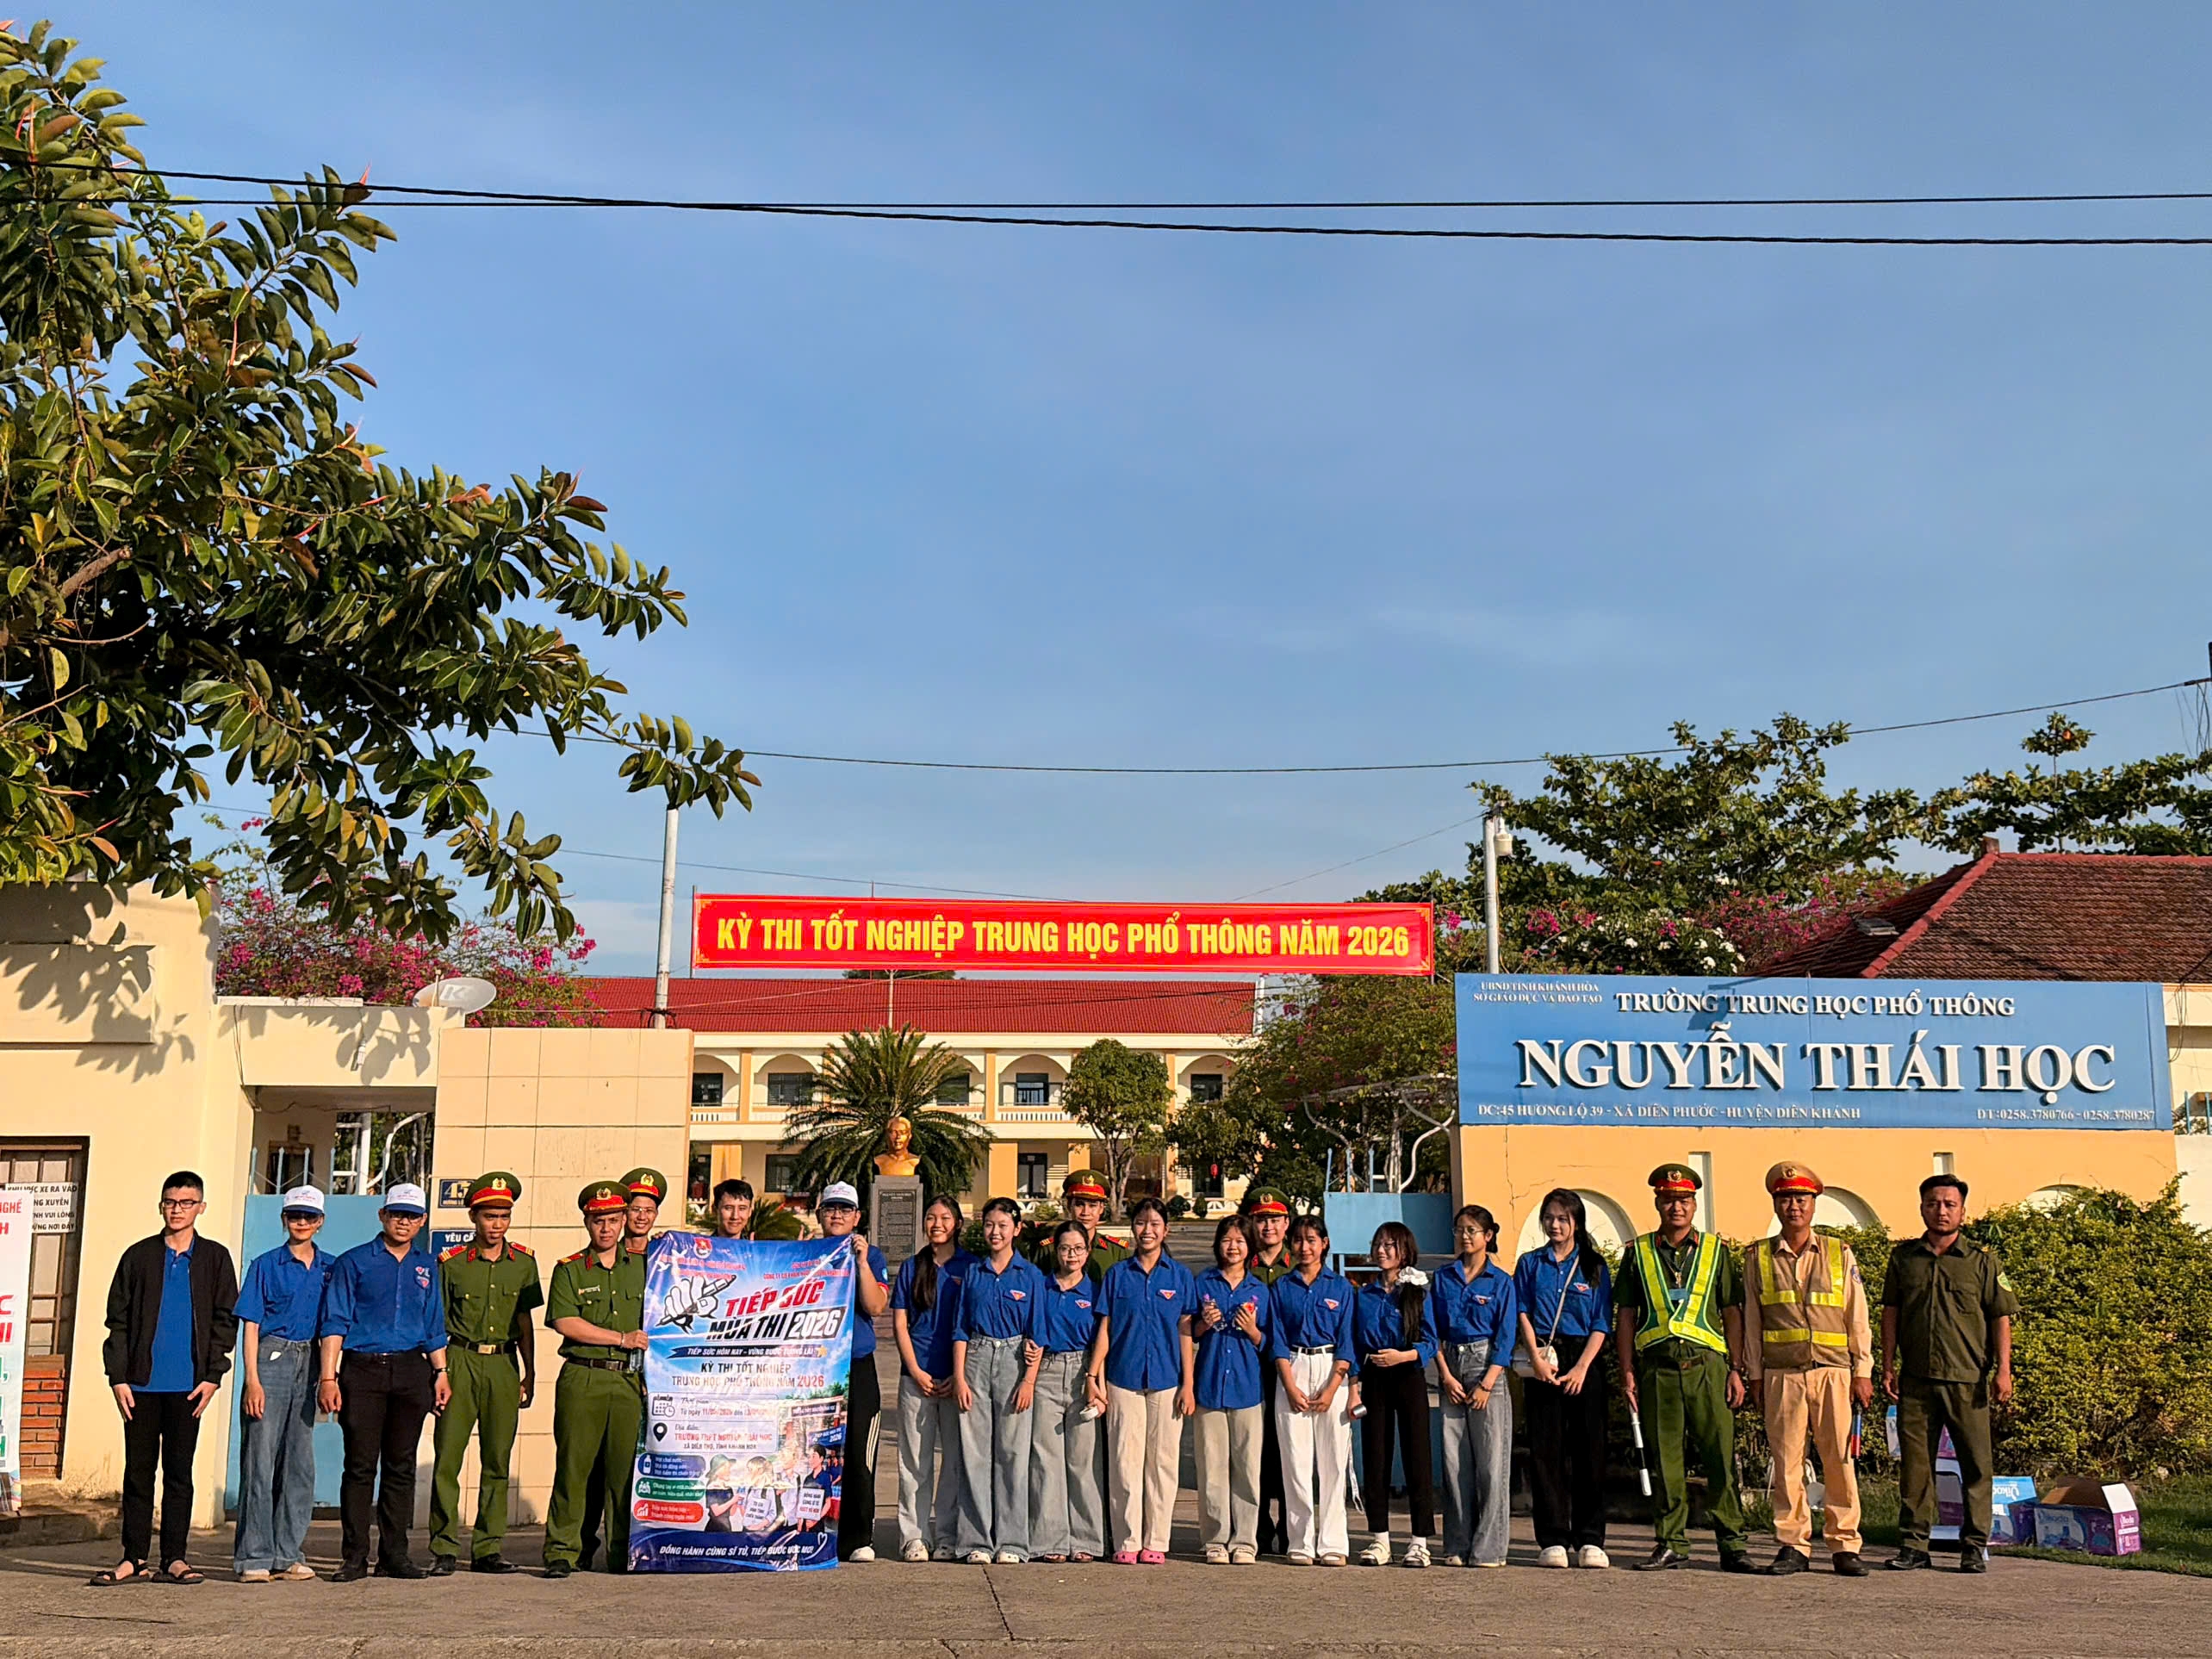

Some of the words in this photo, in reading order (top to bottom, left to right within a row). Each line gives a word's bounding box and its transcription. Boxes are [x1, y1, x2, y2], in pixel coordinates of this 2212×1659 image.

[718, 911, 752, 949] KỲ
[761, 919, 802, 950] THI
[811, 909, 858, 950] TỐT
[867, 914, 964, 958] NGHIỆP
[972, 921, 1059, 952] TRUNG
[1067, 922, 1119, 960] HỌC
[1128, 910, 1180, 954] PHỔ
[1187, 917, 1271, 954] THÔNG
[1280, 918, 1339, 955] NĂM
[1347, 926, 1409, 956] 2026
[1482, 981, 1509, 991] UBND
[1615, 987, 1718, 1013] TRƯỜNG
[1724, 995, 1808, 1014] TRUNG
[1815, 995, 1867, 1019] HỌC
[1873, 988, 1923, 1016] PHỔ
[1929, 991, 2015, 1016] THÔNG
[1516, 1021, 1788, 1090] NGUYỄN
[1805, 1029, 1965, 1090] THÁI
[1978, 1044, 2116, 1104] HỌC
[1590, 1105, 1603, 1116] 39
[1614, 1103, 1633, 1117] XÃ
[1811, 1103, 1861, 1118] KHÁNH
[444, 1181, 471, 1198] 45
[444, 1232, 462, 1242] YÊU
[725, 1286, 778, 1317] TIẾP
[779, 1277, 826, 1308] SỨC
[706, 1317, 752, 1340] MÙA
[753, 1314, 788, 1339] THI
[791, 1310, 841, 1338] 2026
[701, 1361, 713, 1373] KỲ
[718, 1363, 733, 1373] THI
[736, 1361, 753, 1374] TỐT
[672, 1376, 700, 1386] TRUNG
[798, 1375, 824, 1387] 2026
[659, 1544, 682, 1555] ĐỒNG
[681, 1546, 705, 1556] HÀNH
[705, 1546, 727, 1556] CÙNG
[751, 1545, 767, 1555] TIẾP
